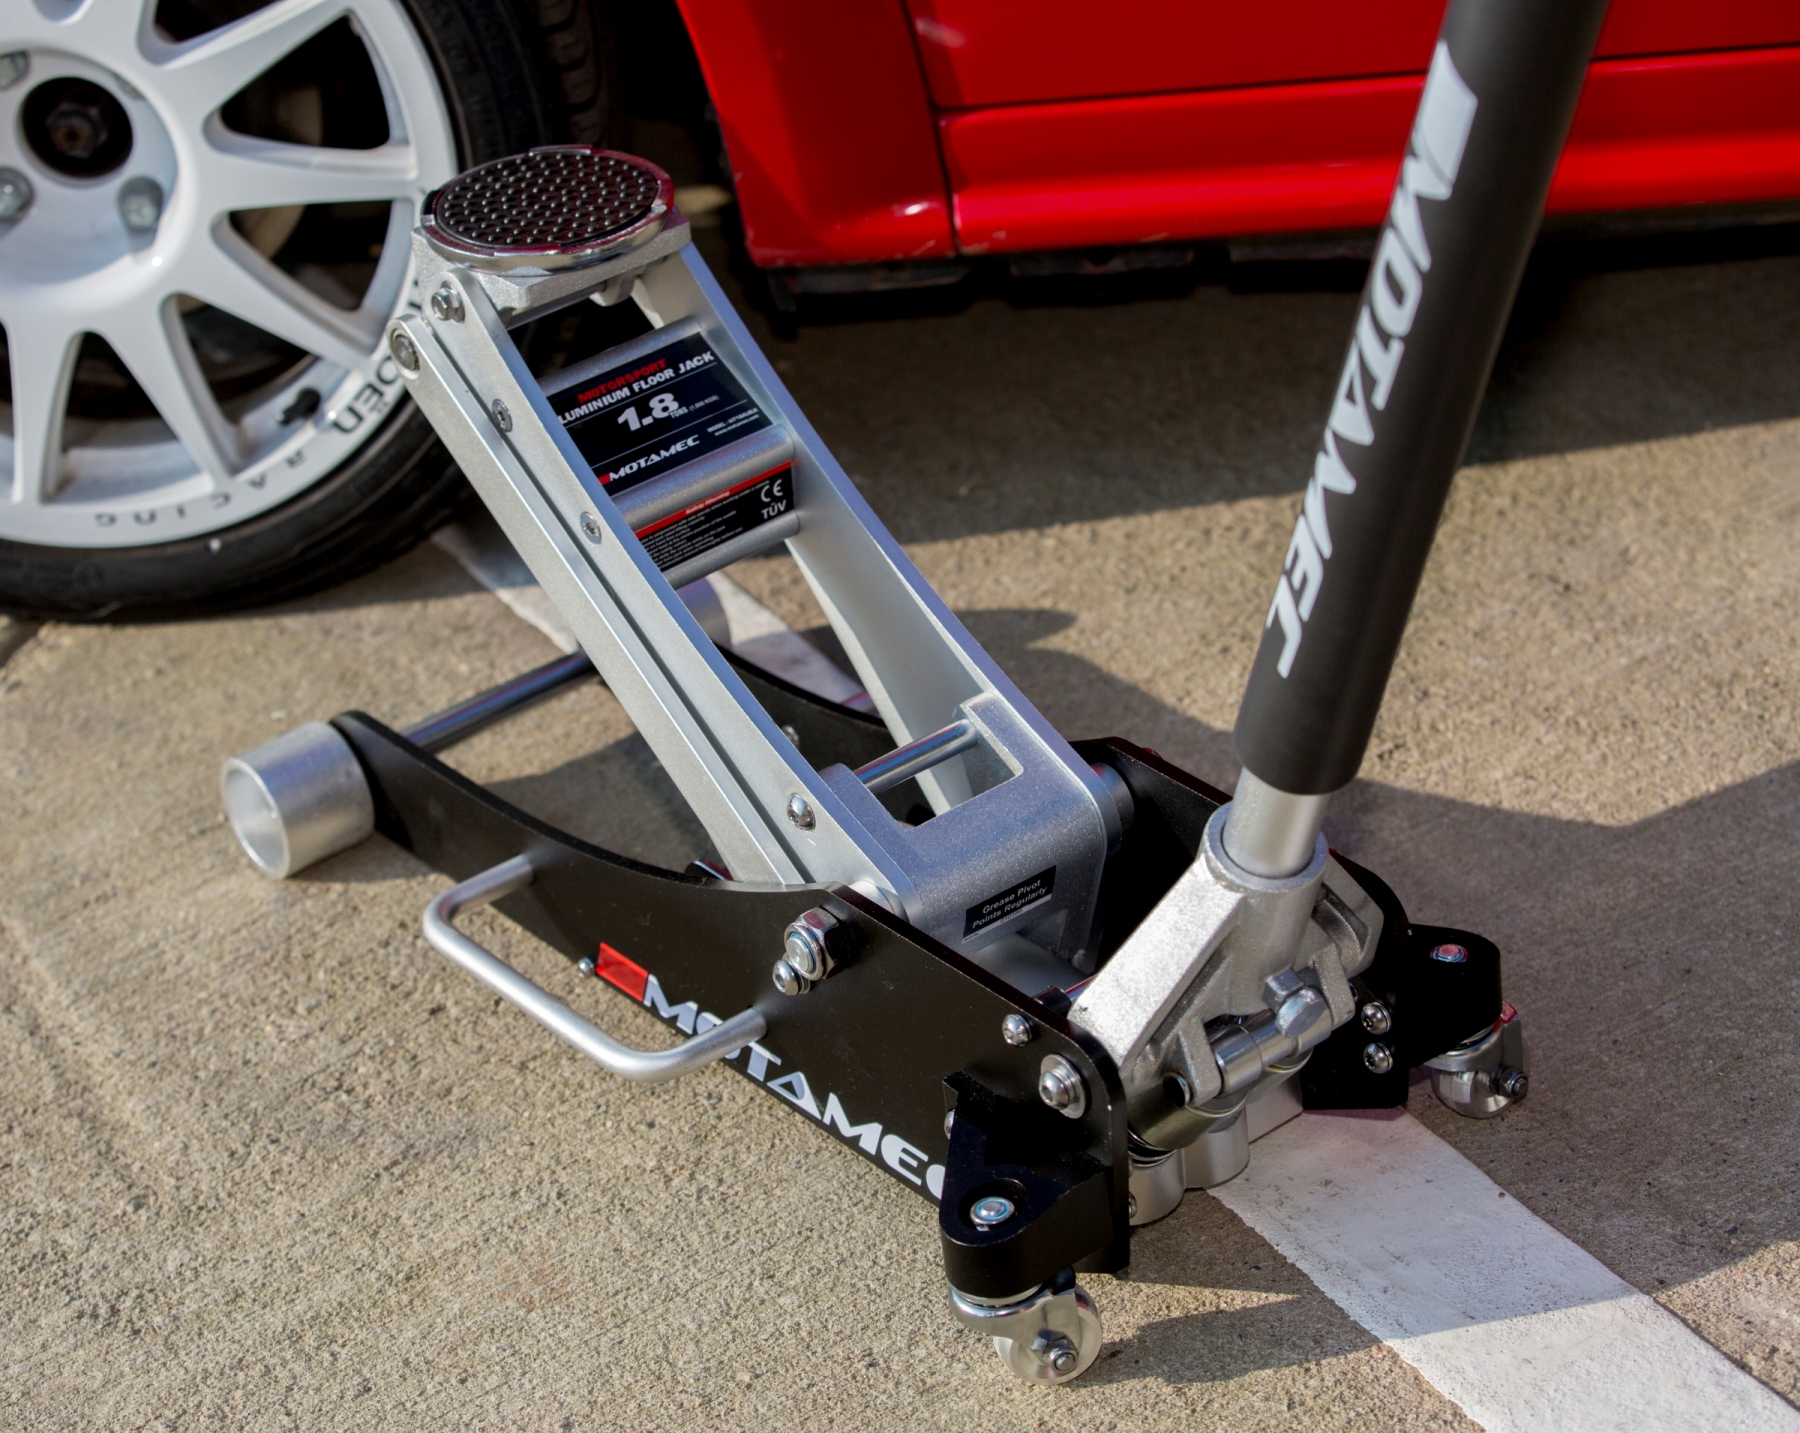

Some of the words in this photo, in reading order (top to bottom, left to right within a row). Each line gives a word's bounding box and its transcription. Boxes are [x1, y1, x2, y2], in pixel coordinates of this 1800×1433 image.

[557, 386, 631, 425] LUMINIUM
[632, 368, 675, 392] FLOOR
[678, 351, 714, 373] JACK
[577, 358, 666, 403] MOTORSPORT
[617, 392, 680, 431] 1.8
[668, 406, 688, 418] TONS
[1266, 129, 1452, 680] MOTAMEC
[608, 434, 700, 481] MOTAMEC
[761, 499, 786, 519] TÜV
[971, 910, 1002, 929] Points
[1003, 886, 1047, 913] Regularly
[982, 893, 1015, 914] Grease
[1017, 879, 1041, 897] Pivot
